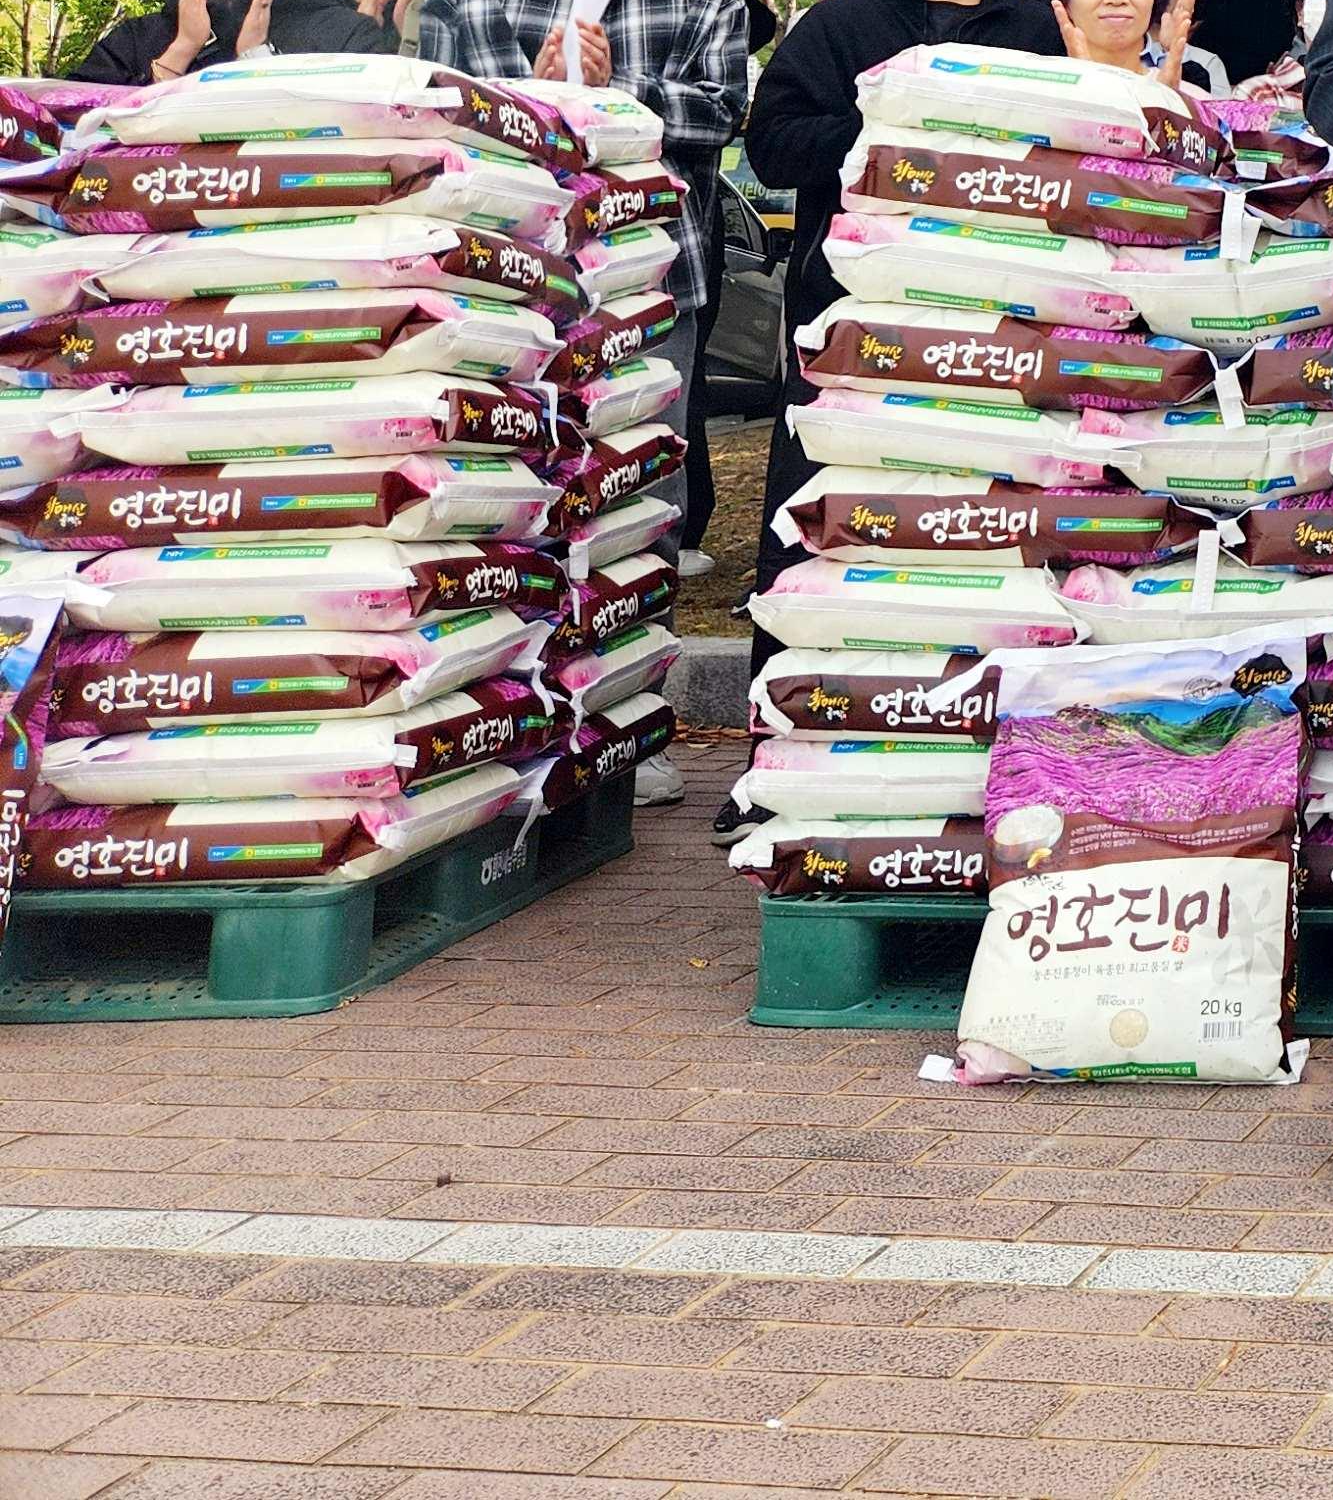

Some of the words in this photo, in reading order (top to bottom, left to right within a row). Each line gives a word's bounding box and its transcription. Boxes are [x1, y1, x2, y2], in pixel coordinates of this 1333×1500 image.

[132, 162, 262, 205] 영호진미
[891, 158, 936, 186] 황매산
[955, 165, 1073, 210] 영호진미
[914, 219, 934, 229] NH
[116, 320, 249, 364] 영호진미
[860, 335, 904, 362] 황매산
[922, 336, 1044, 382] 영호진미
[109, 485, 243, 530] 영호진미
[849, 501, 898, 531] 황매산
[916, 499, 1039, 543] 영호진미
[166, 548, 187, 559] NH
[848, 571, 868, 580] NH
[81, 668, 214, 715] 영호진미
[1236, 666, 1291, 689] 황매산
[807, 685, 850, 712] 황매산
[835, 741, 855, 751] NH
[54, 834, 190, 879] 영호진미
[803, 850, 848, 876] 황매산
[1006, 881, 1231, 962] 영호진미
[1200, 999, 1221, 1016] 20
[1224, 998, 1243, 1018] kg
